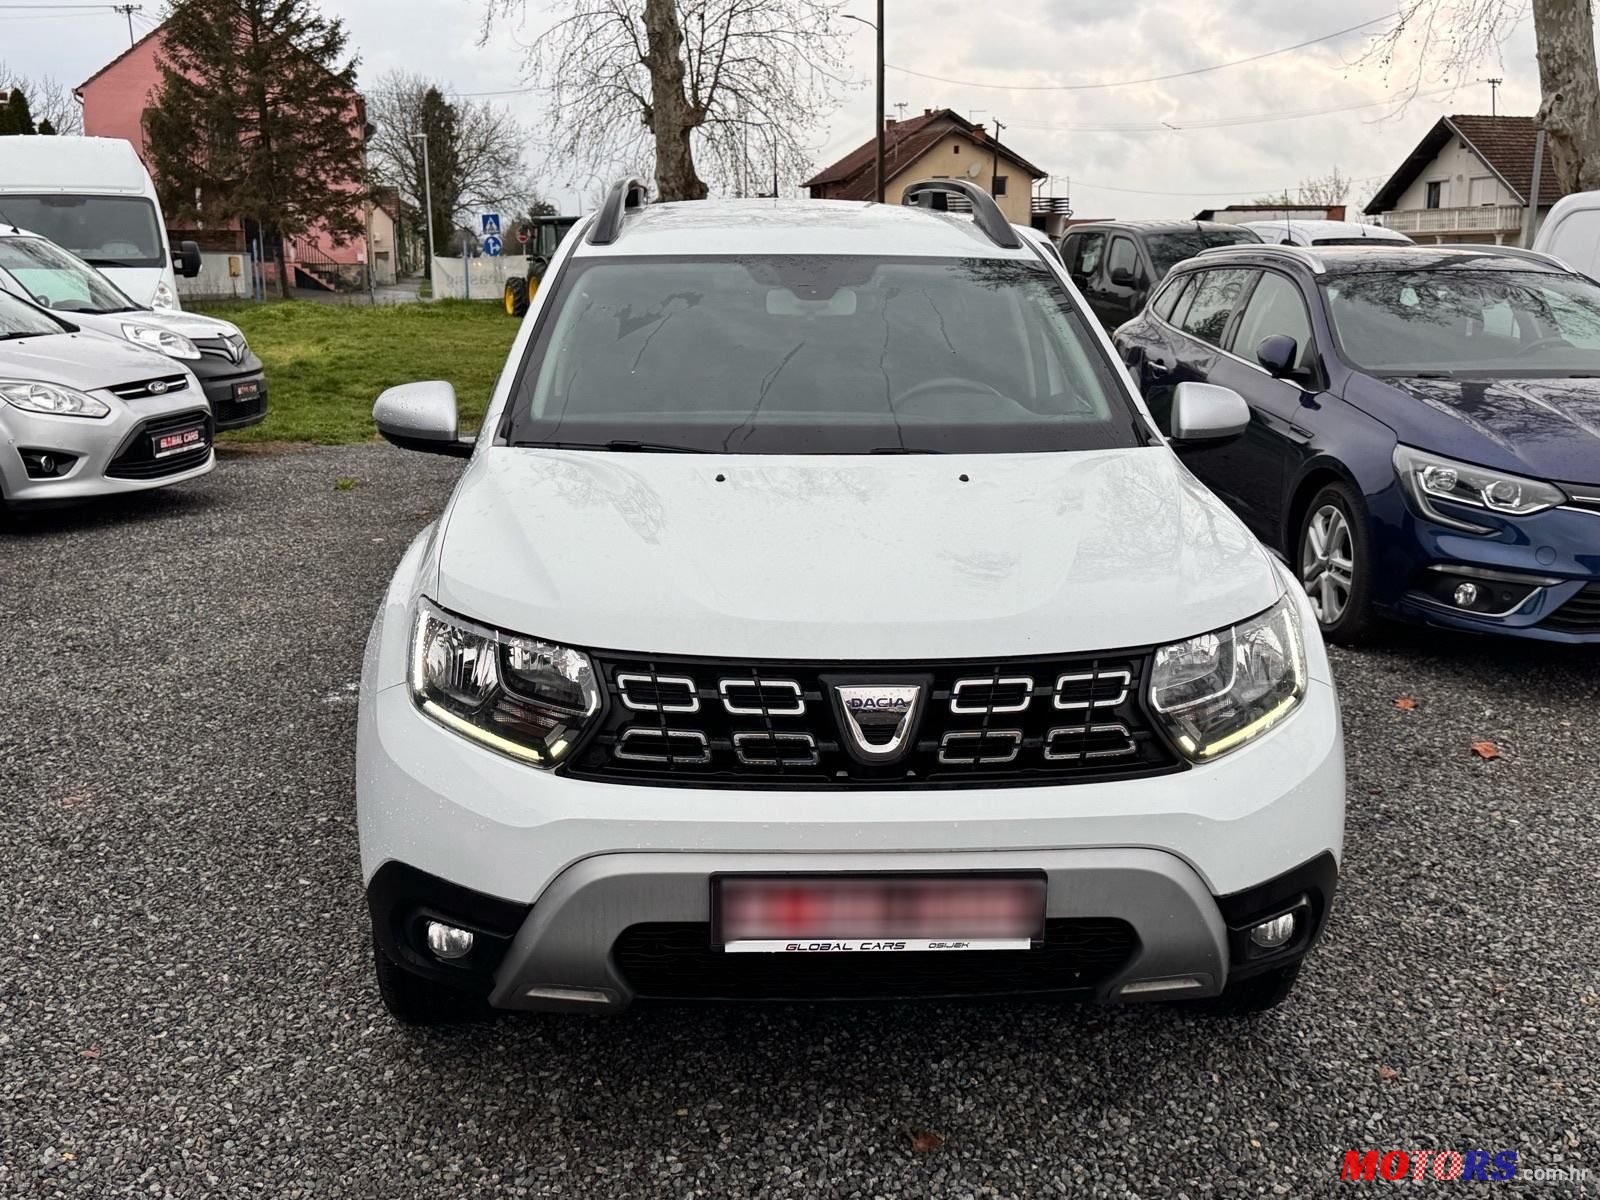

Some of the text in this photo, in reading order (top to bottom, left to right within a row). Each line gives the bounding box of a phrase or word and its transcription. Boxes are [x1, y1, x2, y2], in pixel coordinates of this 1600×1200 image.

[183, 430, 199, 442] CARS
[851, 697, 906, 708] DACIA
[785, 942, 971, 952] GLOBAL CARS OSIJEK
